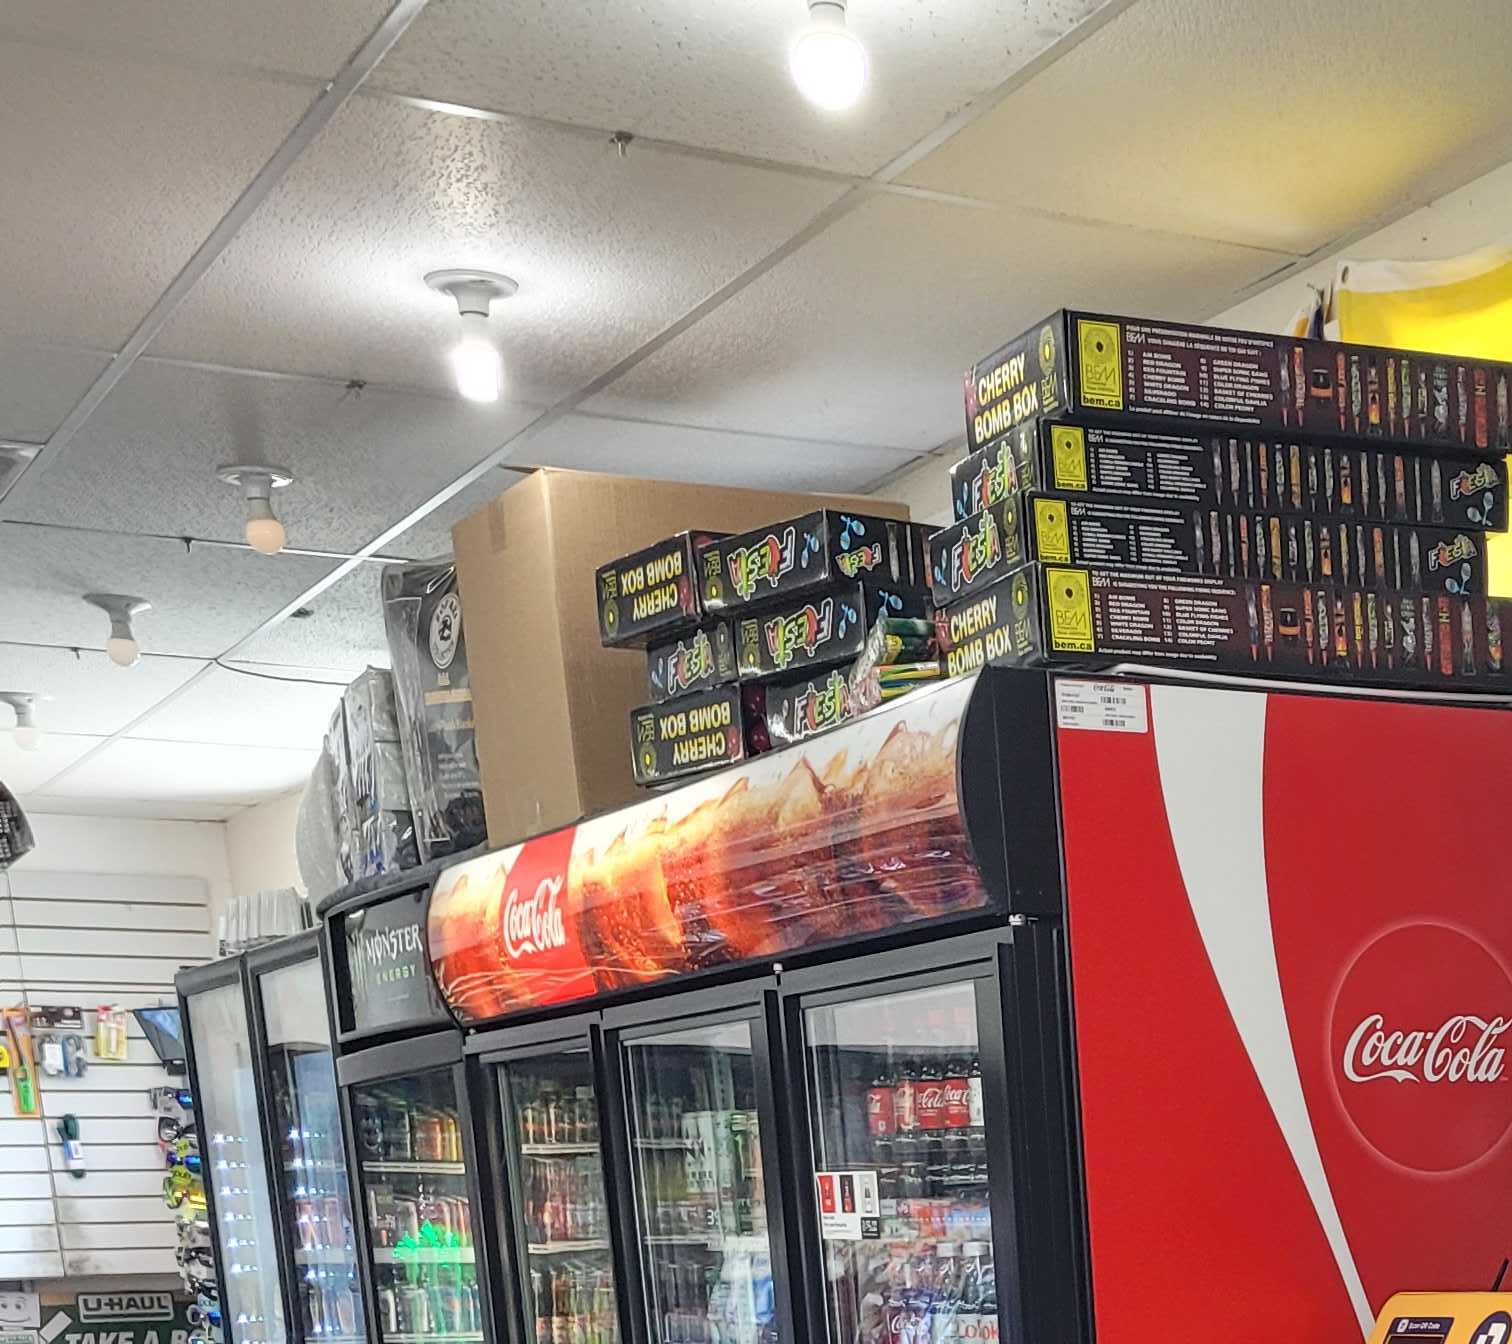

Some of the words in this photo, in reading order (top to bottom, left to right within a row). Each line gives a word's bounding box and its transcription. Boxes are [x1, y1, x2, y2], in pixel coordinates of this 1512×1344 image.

[978, 353, 1025, 407] CHERRY
[974, 403, 1012, 444] BOMB
[1013, 380, 1040, 423] BOX
[1081, 395, 1121, 409] bem.ca
[620, 566, 644, 590] BOX
[644, 550, 682, 586] BOMB
[633, 583, 678, 621] CHERRY
[951, 596, 998, 642] CHERRY
[947, 641, 985, 678] BOMB
[985, 625, 1012, 665] BOX
[1054, 640, 1093, 650] bem.ca
[660, 711, 687, 739] BOX
[690, 701, 730, 730] BOMB
[672, 732, 726, 766] CHERRY
[366, 924, 423, 966] MONSTER
[376, 964, 416, 985] ENERGY
[83, 1296, 170, 1312] U-HAUL
